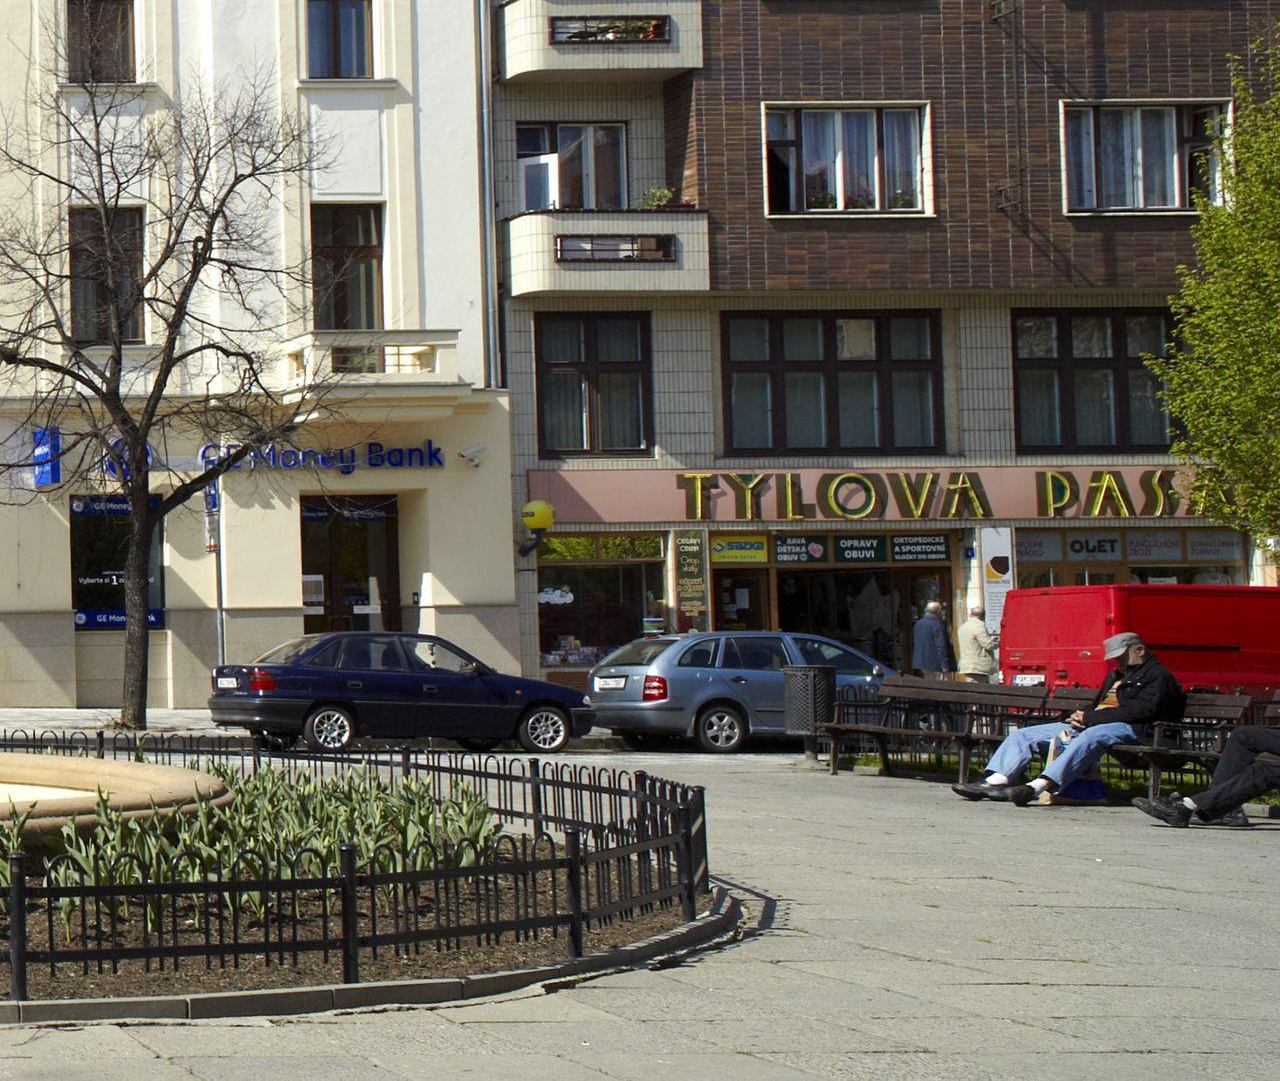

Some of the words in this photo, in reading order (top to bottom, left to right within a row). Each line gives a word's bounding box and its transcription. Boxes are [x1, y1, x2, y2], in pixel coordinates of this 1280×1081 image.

[250, 443, 356, 475] Money
[367, 439, 444, 468] Bank
[676, 472, 995, 519] TYLOVA
[840, 539, 877, 548] OPRAVY
[901, 544, 946, 552] SPORTOVNÍ
[844, 550, 875, 559] OBUVI
[78, 577, 103, 585] Vyberte
[111, 575, 118, 585] 1
[96, 614, 107, 622] GE
[109, 614, 126, 622] Mon
